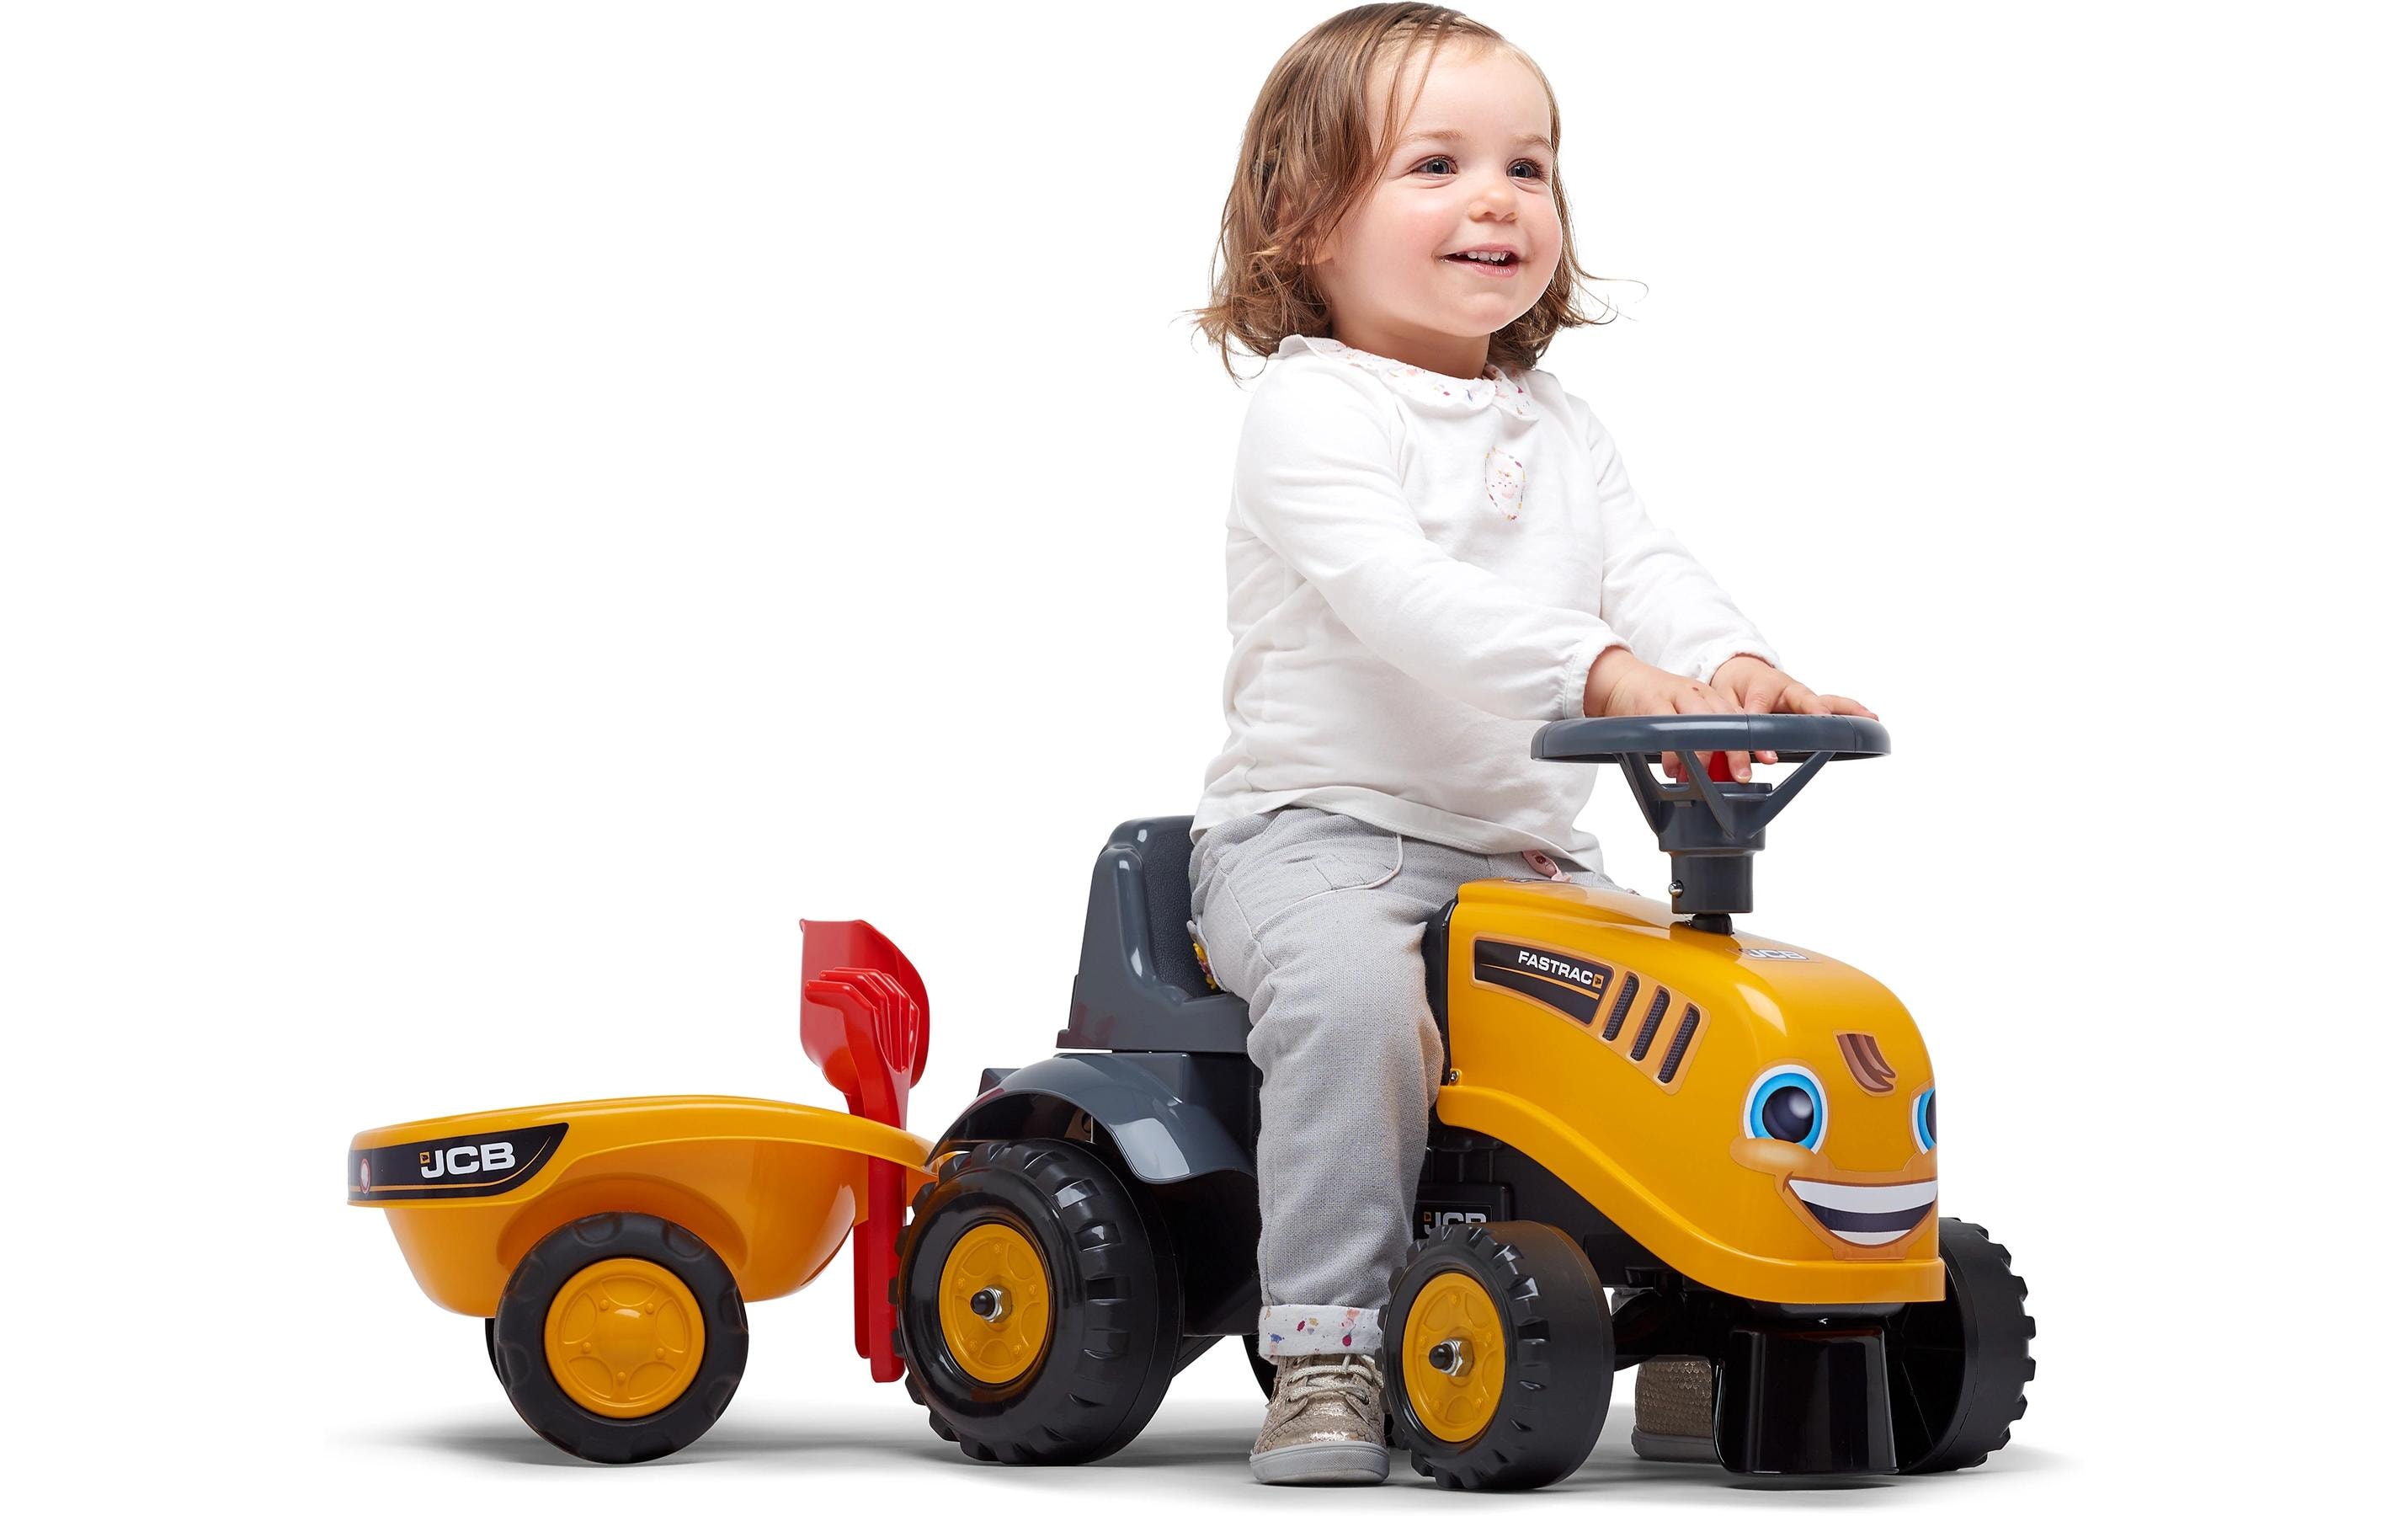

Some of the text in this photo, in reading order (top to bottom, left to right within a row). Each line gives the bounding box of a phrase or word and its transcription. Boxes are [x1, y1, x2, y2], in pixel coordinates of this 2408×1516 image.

[1518, 950, 1594, 985] FASTRAC
[1749, 948, 1809, 960] JCB
[420, 1141, 516, 1179] JCB
